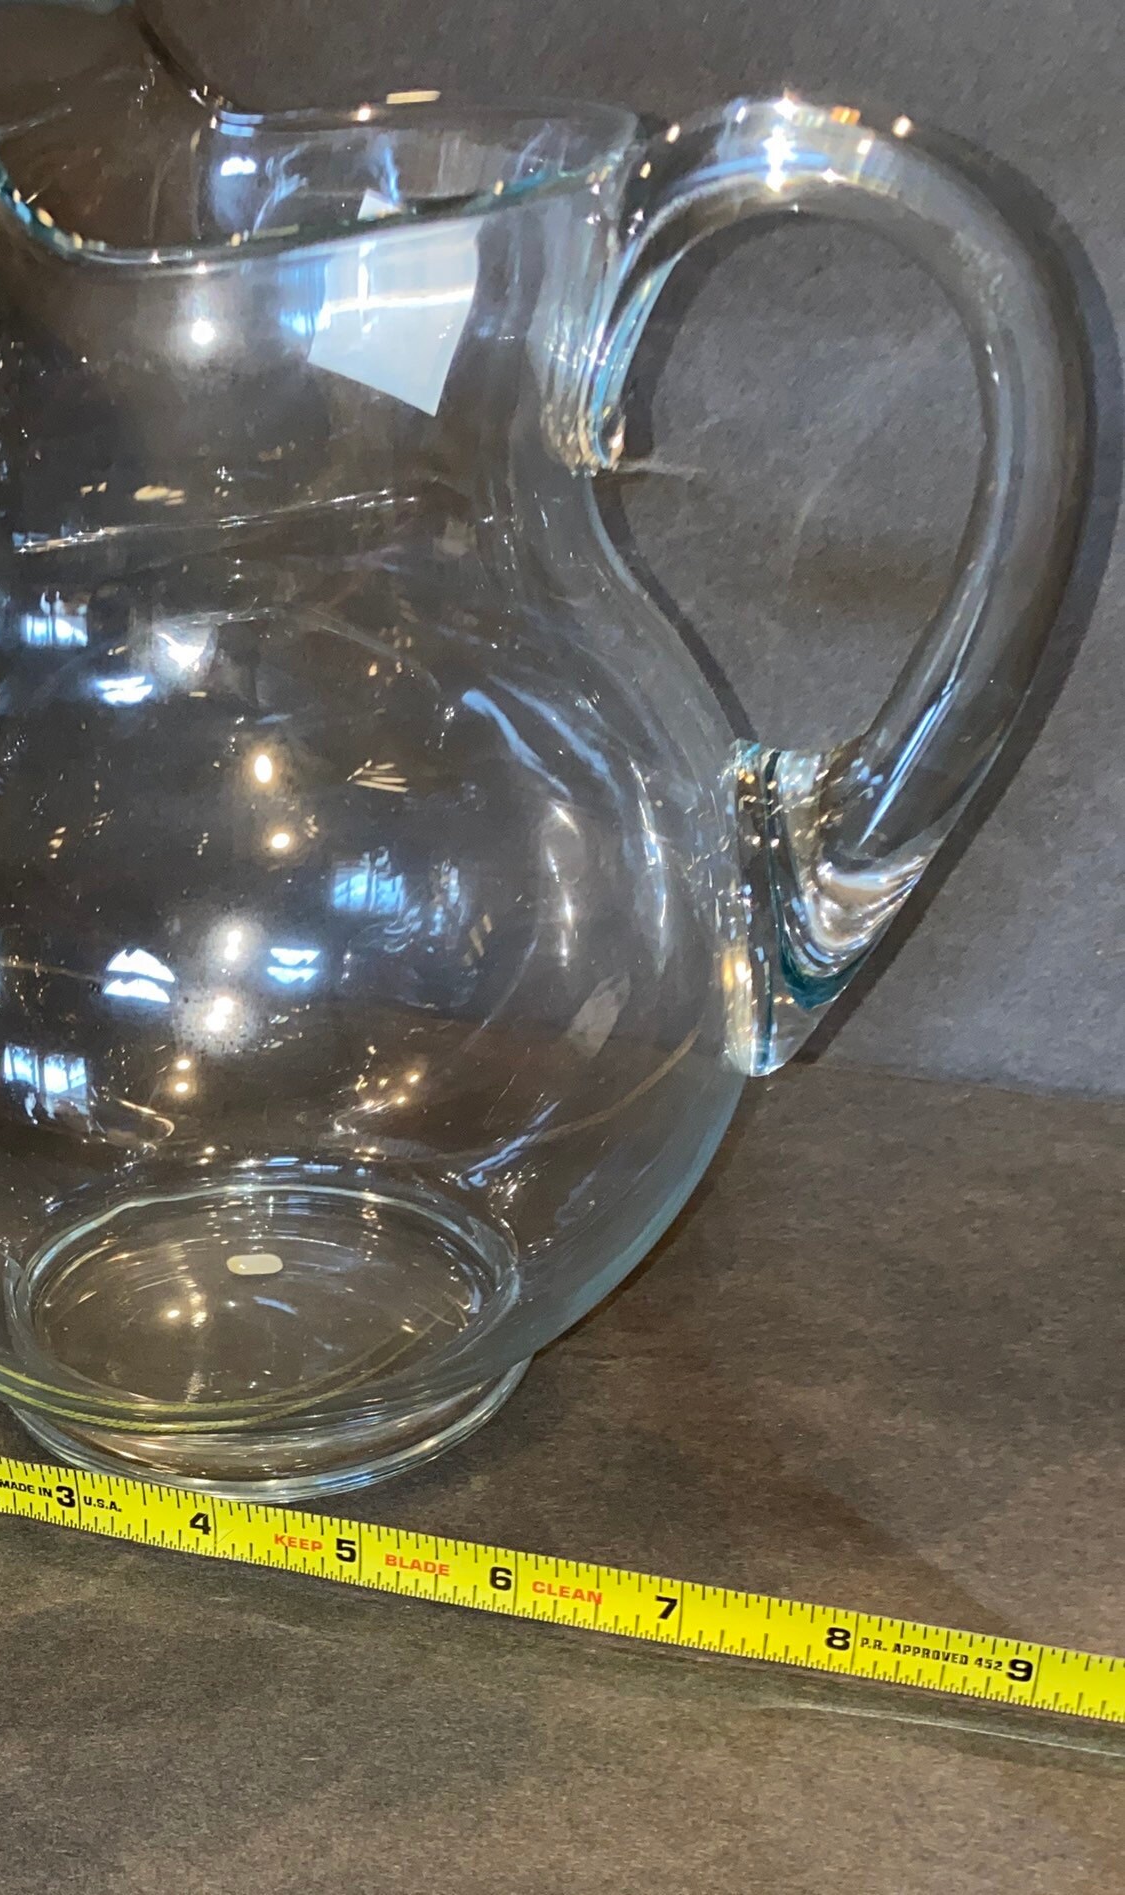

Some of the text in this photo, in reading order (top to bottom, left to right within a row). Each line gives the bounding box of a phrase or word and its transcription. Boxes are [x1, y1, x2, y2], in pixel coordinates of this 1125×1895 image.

[38, 1487, 53, 1498] IN
[83, 1495, 122, 1512] U.S.A.
[56, 1486, 76, 1508] 3
[189, 1512, 211, 1535] 4
[335, 1538, 356, 1563] 5
[274, 1534, 603, 1605] KEEP BLADE CLEAN
[489, 1566, 513, 1591] 6
[655, 1596, 678, 1620] 7
[826, 1627, 851, 1651] 8
[860, 1637, 1003, 1672] P.R. APPROVED 452
[1006, 1659, 1034, 1682] 9
